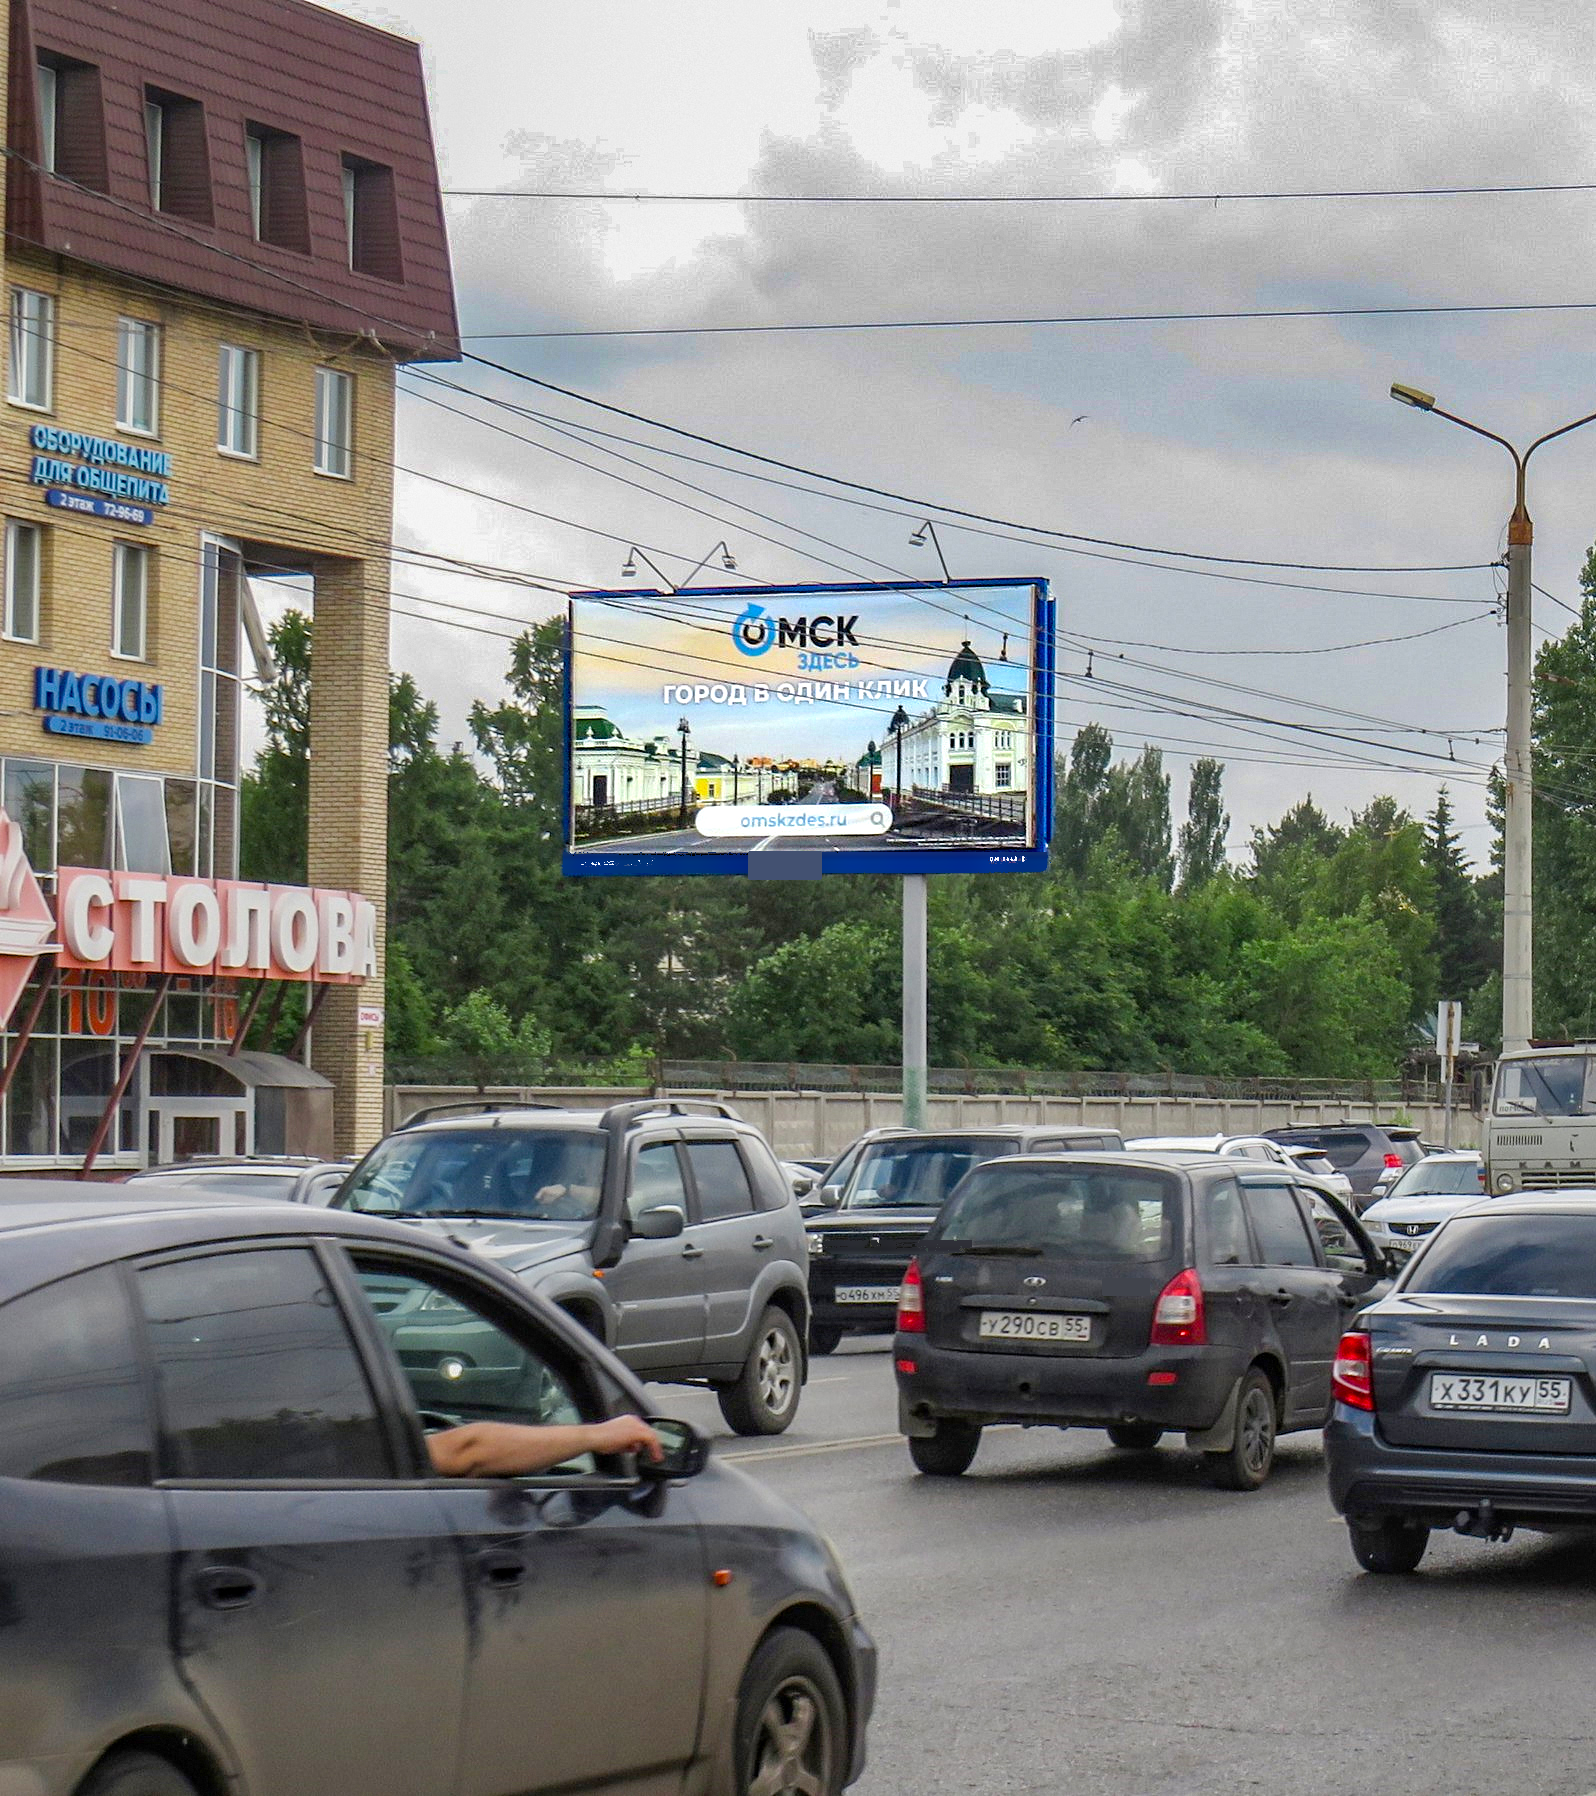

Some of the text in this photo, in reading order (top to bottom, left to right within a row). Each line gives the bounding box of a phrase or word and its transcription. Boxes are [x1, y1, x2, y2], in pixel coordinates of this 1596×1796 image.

[33, 424, 173, 477] ОБОРУДОВАНИЕ
[34, 456, 169, 506] ДЛЯ ОБЩЕПИТА
[60, 493, 145, 523] 2 этаж 72-96-69
[733, 602, 859, 656] ОМСК
[797, 652, 859, 672] ЗДЕСЬ
[35, 667, 164, 726] НАСОСЫ
[663, 678, 929, 706] ГОРОД В ОДИН КЛИК
[740, 811, 847, 829] omskzdes.ru
[989, 1315, 1084, 1336] У290СВ 55
[1449, 1335, 1551, 1349] LADA
[1440, 1379, 1561, 1404] Х331КУ 55
